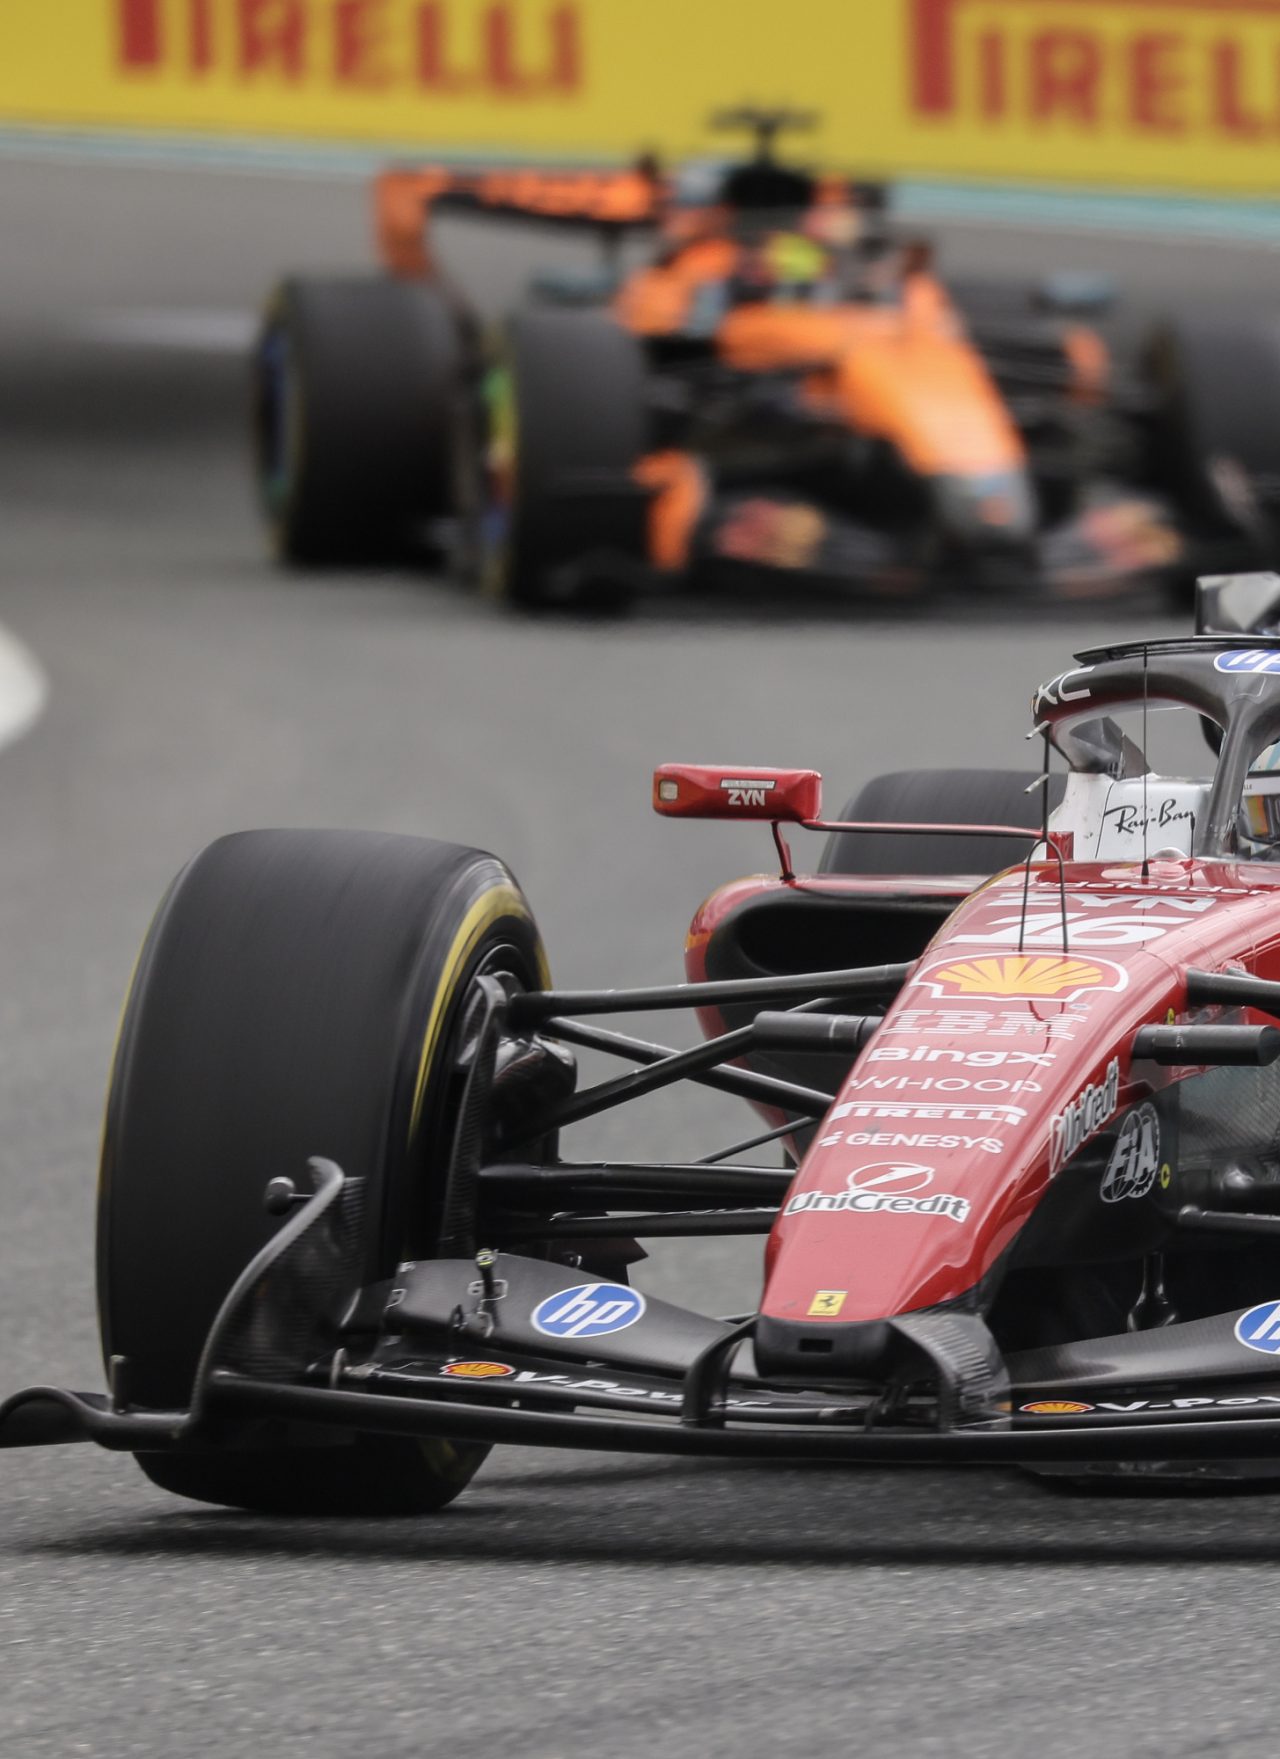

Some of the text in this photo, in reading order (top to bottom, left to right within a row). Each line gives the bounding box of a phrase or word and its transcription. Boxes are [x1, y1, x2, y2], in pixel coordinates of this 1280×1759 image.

[727, 789, 766, 807] ZYN
[1103, 798, 1196, 836] Ray-Ban
[985, 892, 1217, 912] ZYN
[942, 912, 1196, 945] 16
[880, 1009, 1088, 1041] IBM
[850, 1075, 1043, 1093] WHOOP
[827, 1101, 1029, 1126] PIRELLI
[845, 1132, 1004, 1154] GENESYS
[784, 1190, 970, 1222] UniCredit
[532, 1283, 643, 1337] hp
